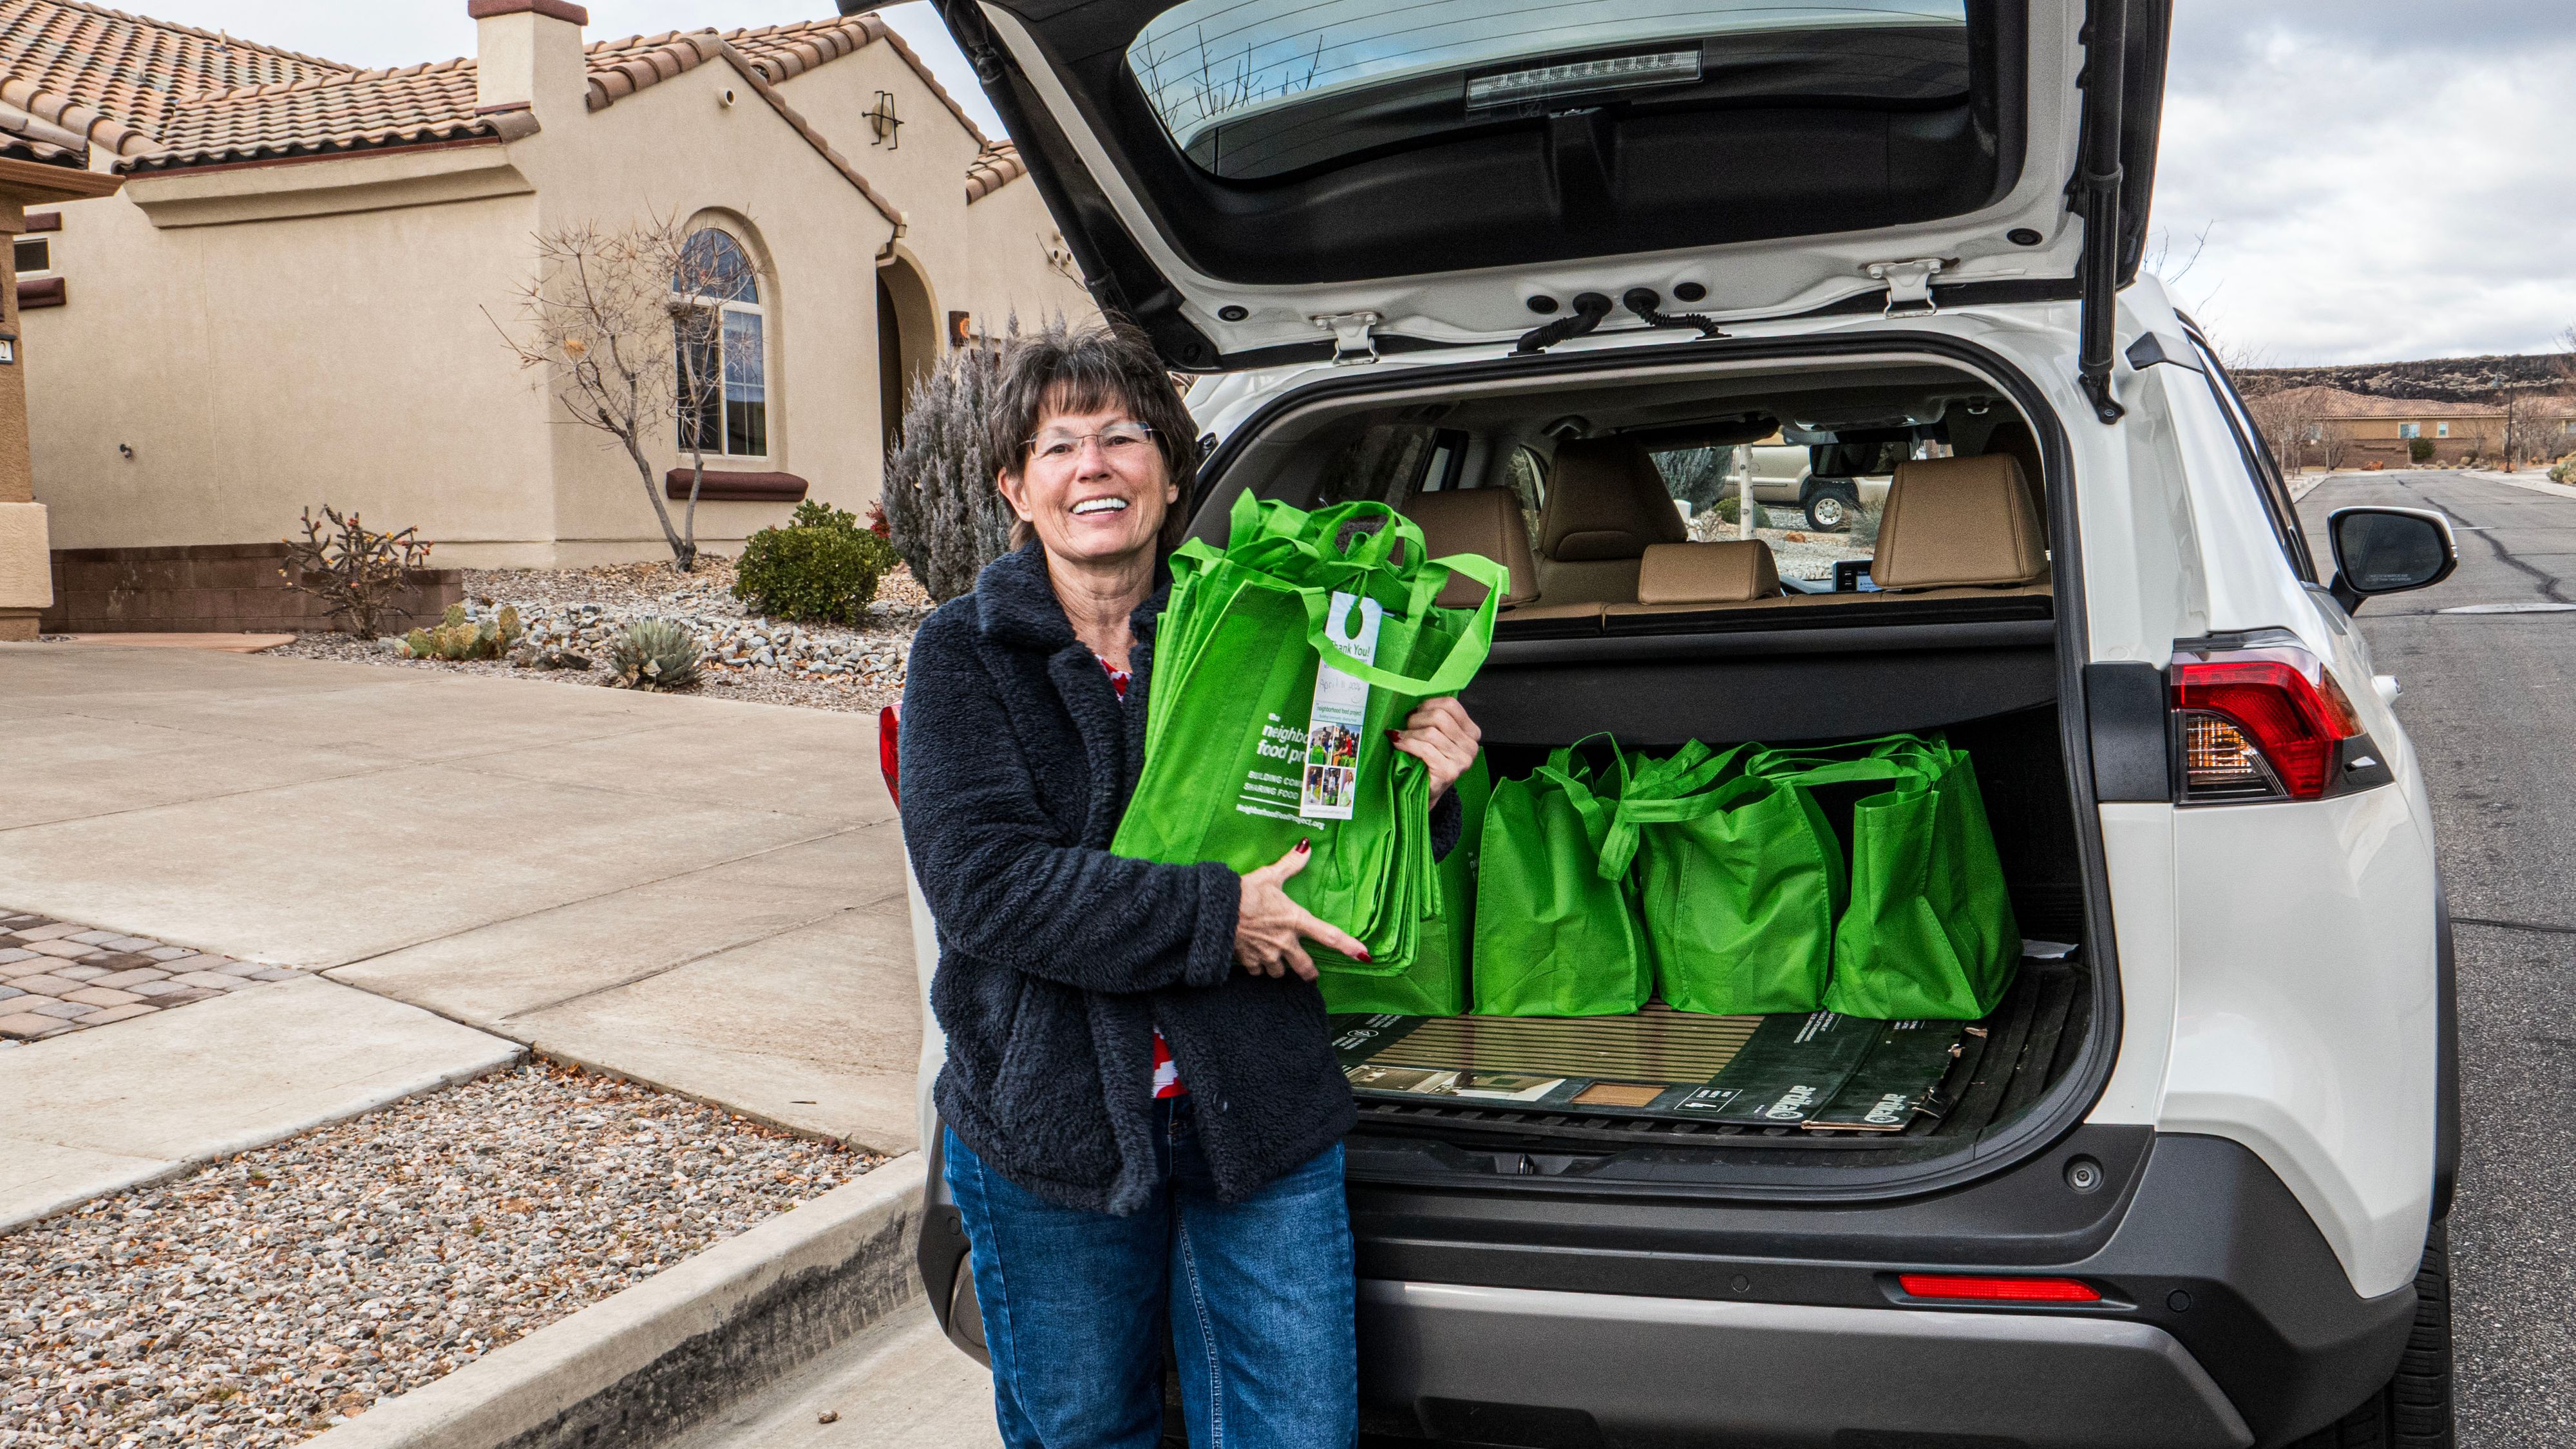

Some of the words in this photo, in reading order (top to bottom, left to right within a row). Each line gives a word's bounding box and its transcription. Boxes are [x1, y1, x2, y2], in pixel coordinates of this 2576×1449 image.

[0, 341, 6, 359] 2
[1354, 643, 1370, 657] You!
[1320, 677, 1338, 692] April
[1268, 712, 1281, 722] the
[1257, 739, 1289, 759] food
[1247, 771, 1282, 784] BUILDING
[1244, 782, 1277, 795] SHARING
[1277, 789, 1300, 800] FOOD
